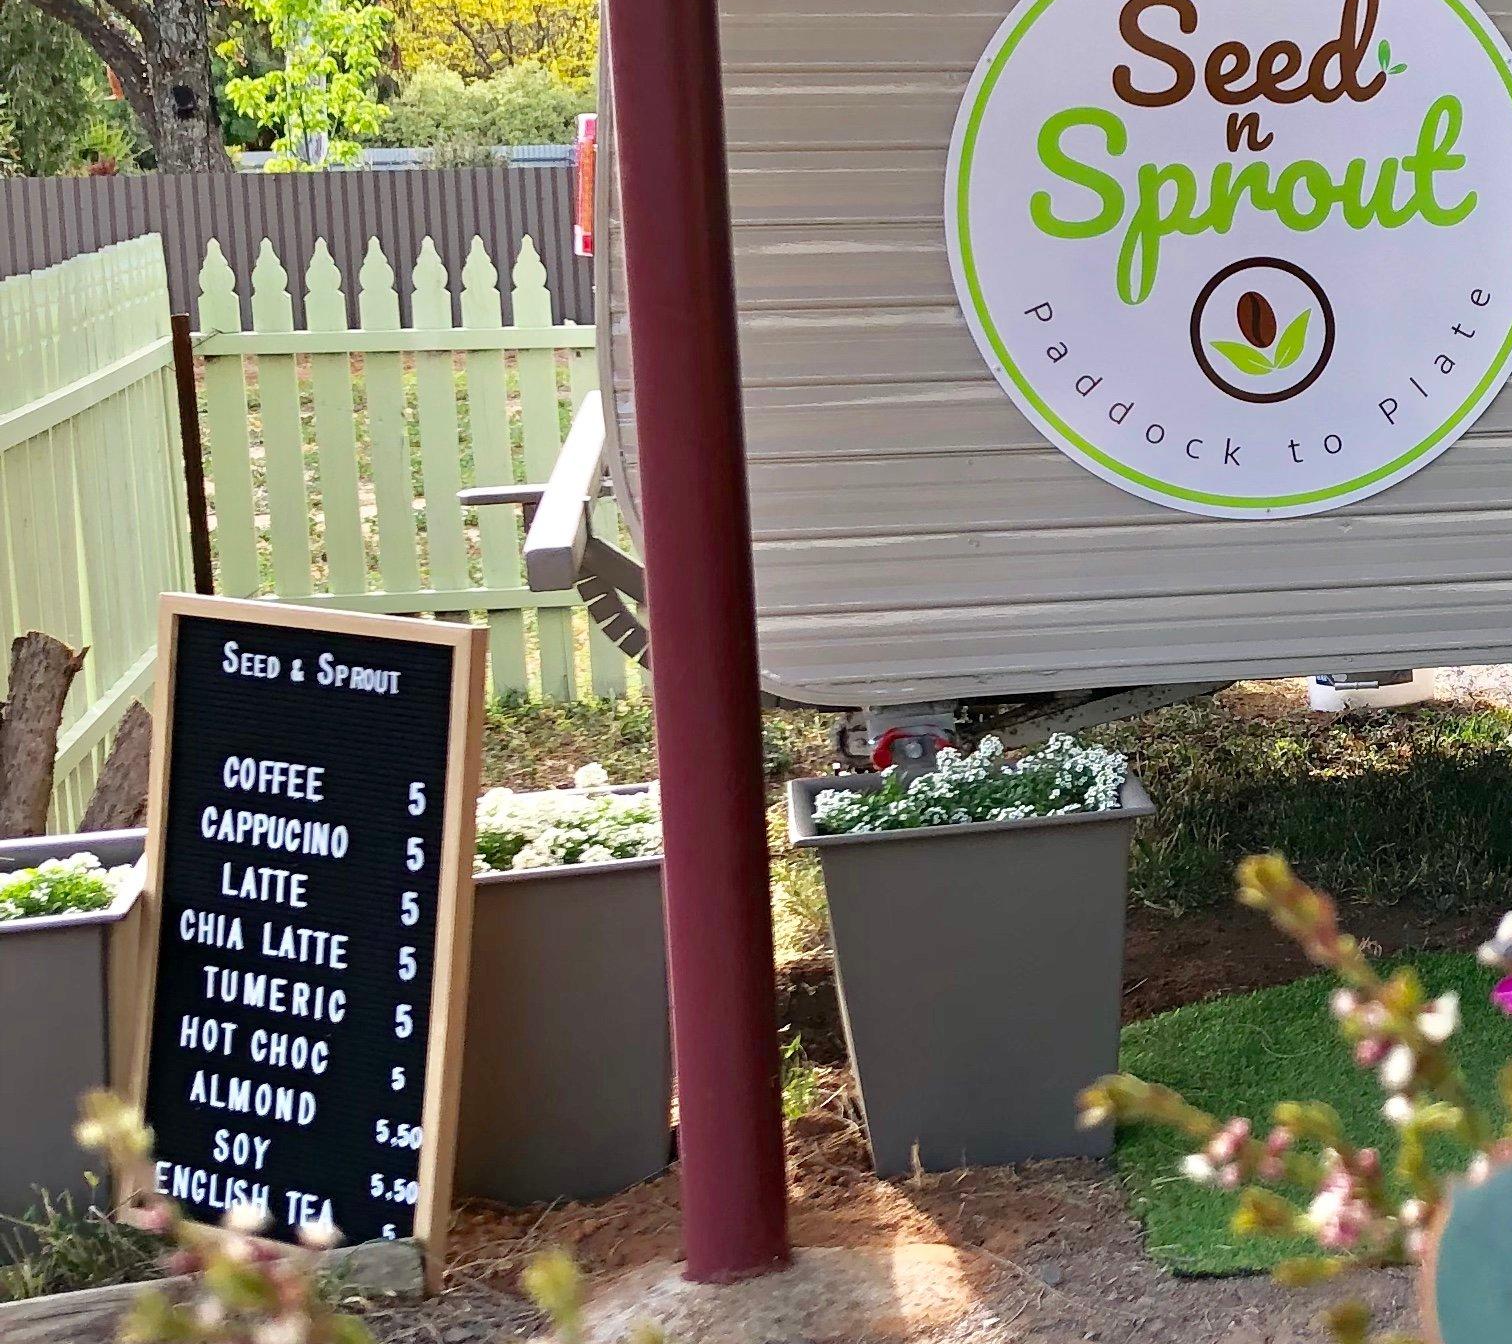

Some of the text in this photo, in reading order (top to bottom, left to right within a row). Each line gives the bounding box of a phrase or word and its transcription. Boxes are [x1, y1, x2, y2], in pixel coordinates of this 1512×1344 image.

[1226, 112, 1274, 153] n
[1030, 94, 1478, 305] Sprout
[1024, 287, 1492, 466] Paddock to Plate
[290, 658, 305, 682] &
[223, 756, 427, 816] COFFEE 5
[201, 806, 425, 872] CAPPUCINO 5
[221, 862, 420, 927] LATTE 5
[180, 909, 417, 981] CHIA LATTE 5
[203, 965, 414, 1038] TUMERIC 5
[180, 1014, 406, 1091] HOT CHOC 5
[189, 1069, 423, 1150] ALMOND 5.50
[154, 1160, 270, 1219] ENGLISH
[285, 1190, 334, 1230] TEA
[213, 1128, 419, 1205] SOY 5.50
